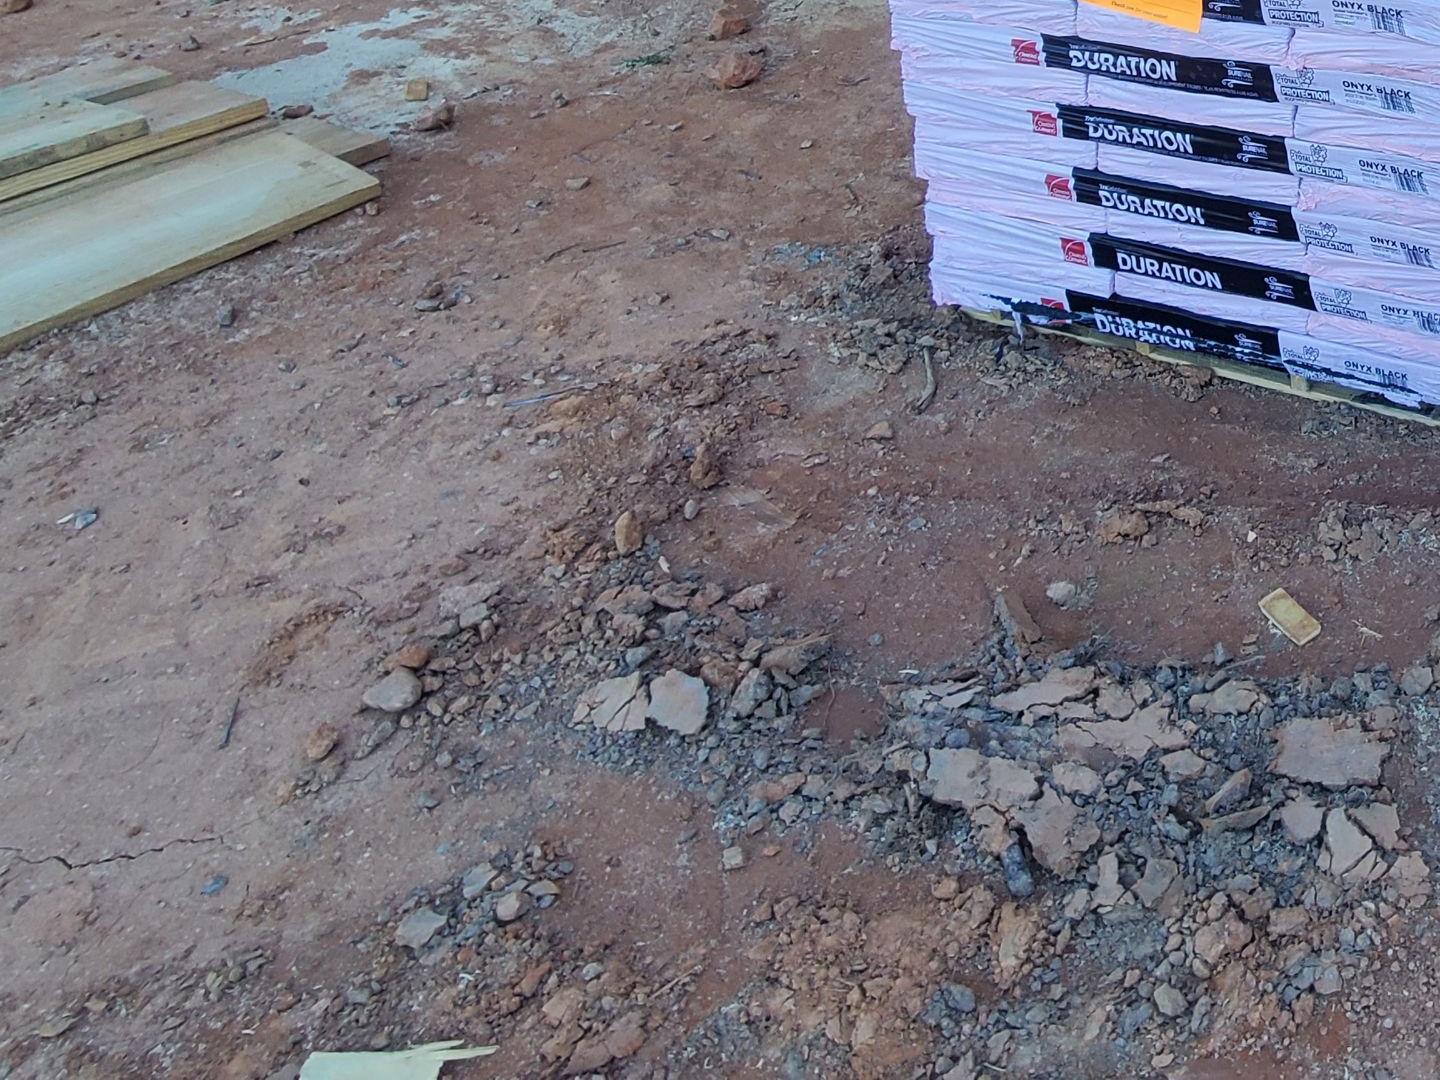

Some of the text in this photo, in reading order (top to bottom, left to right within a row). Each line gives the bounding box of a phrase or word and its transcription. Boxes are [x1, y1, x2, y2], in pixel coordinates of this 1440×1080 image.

[1268, 9, 1321, 24] PROTECTION
[1332, 0, 1403, 18] ONYX BLACK
[1069, 51, 1176, 81] DURATION
[1279, 76, 1299, 86] TOTAL
[1342, 80, 1374, 92] ONYX
[1280, 87, 1329, 102] PROTECTION
[1088, 122, 1193, 153] DURATION
[1294, 153, 1311, 162] TOTAL
[1296, 164, 1343, 180] PROTECTION
[1359, 160, 1424, 180] ONYX BLACK
[1099, 192, 1204, 224] DURATION
[1303, 228, 1321, 237] TOTAL
[1400, 242, 1430, 255] BLACK
[1116, 252, 1222, 289] DURATION
[1381, 304, 1409, 315] ONYX
[1344, 360, 1408, 380] ONYX BLACK
